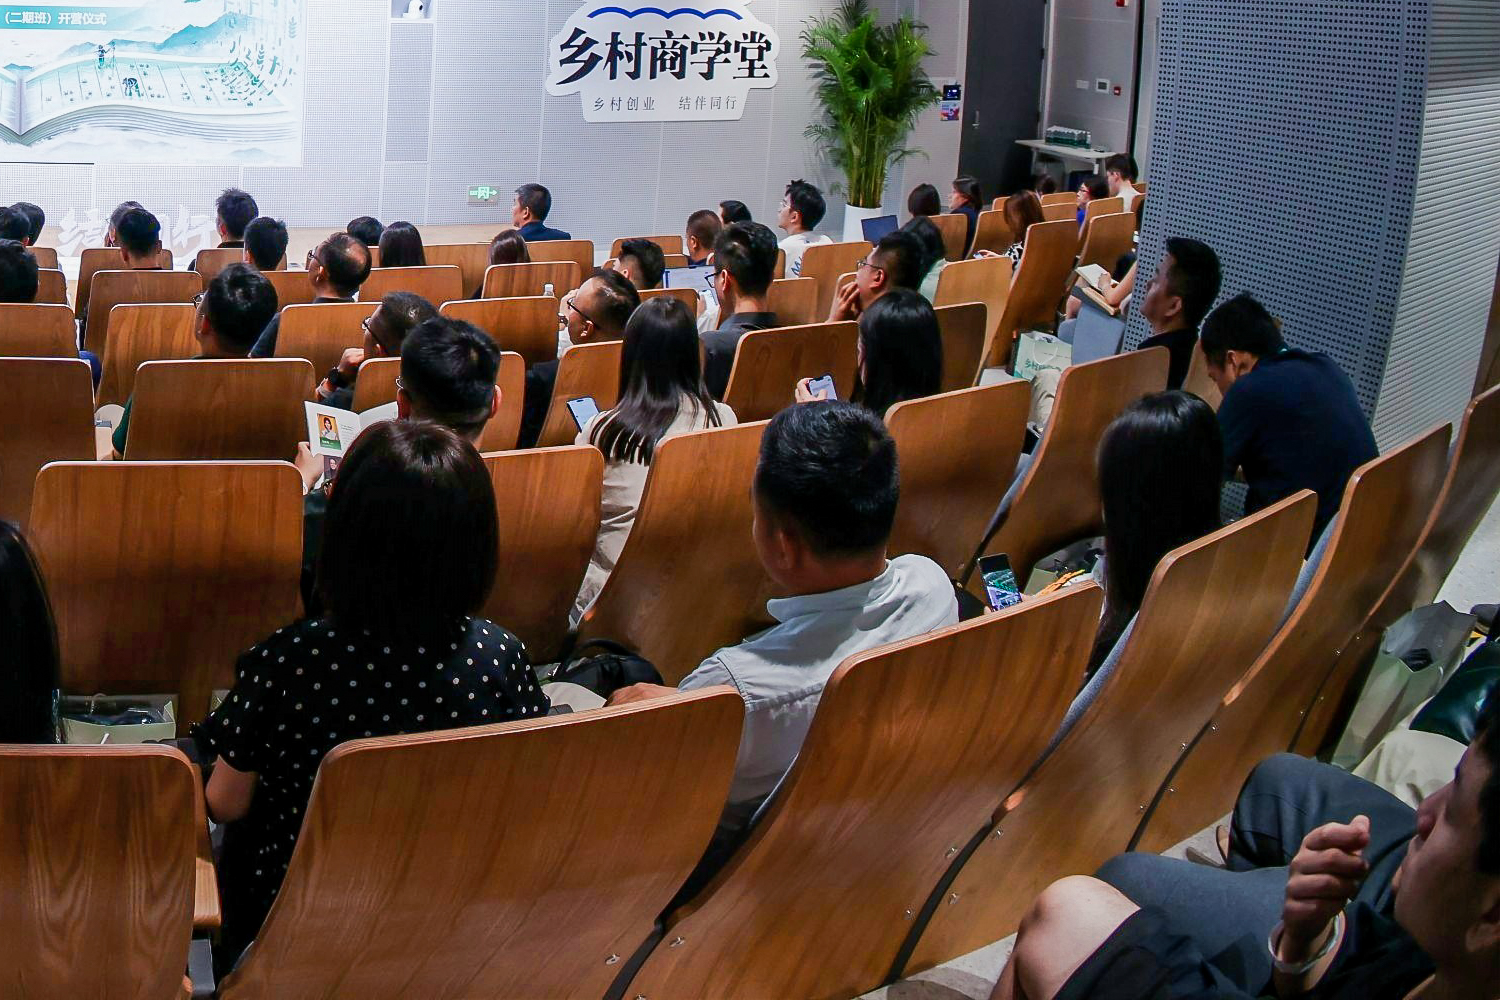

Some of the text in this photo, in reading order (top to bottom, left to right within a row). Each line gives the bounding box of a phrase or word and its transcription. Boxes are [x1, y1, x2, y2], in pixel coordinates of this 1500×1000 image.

[556, 27, 773, 85] 乡村商学堂
[592, 95, 738, 111] 乡村创业 结伴同行
